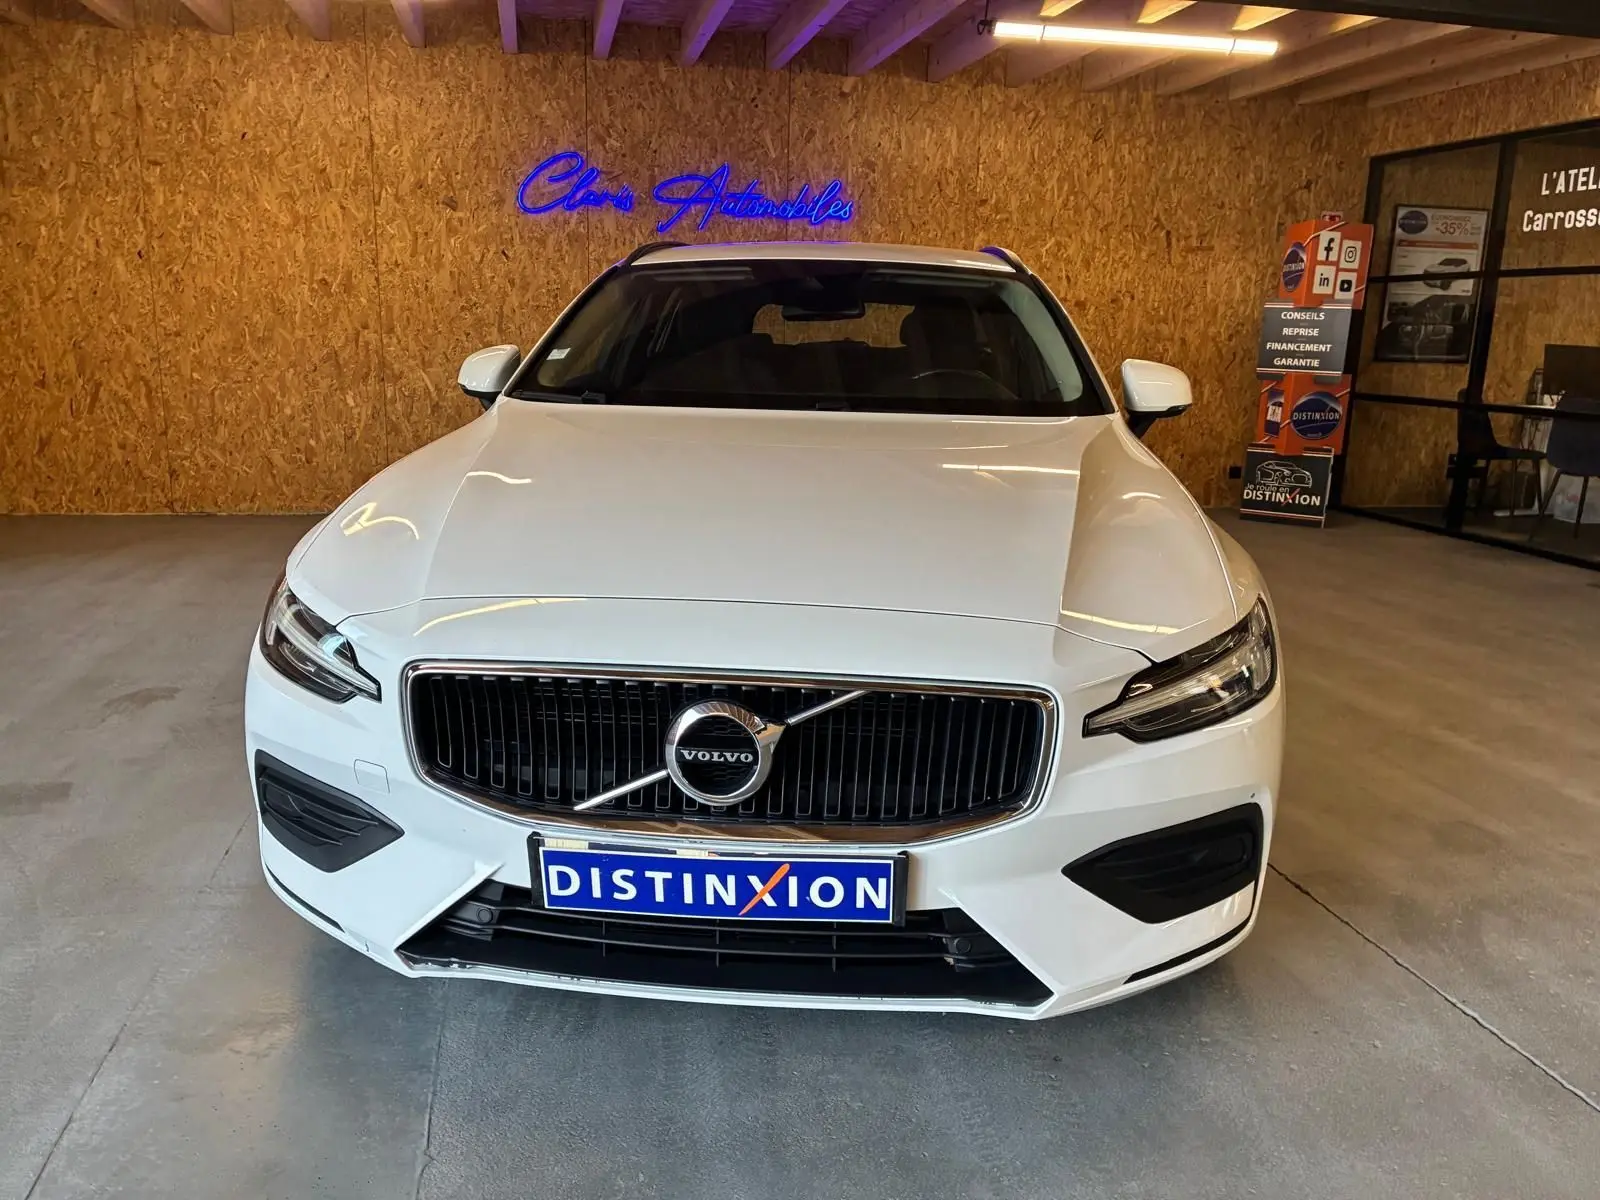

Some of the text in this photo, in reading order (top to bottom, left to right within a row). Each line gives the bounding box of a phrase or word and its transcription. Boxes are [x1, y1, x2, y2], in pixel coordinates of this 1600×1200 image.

[652, 162, 854, 232] Automobiles
[1281, 311, 1326, 321] CONSEILS
[1282, 327, 1320, 337] REPRISE
[1266, 342, 1332, 352] FINANCEMENT
[1273, 357, 1320, 367] GARANTIE
[1293, 411, 1340, 421] DISTINXION
[1256, 484, 1277, 493] roule
[1243, 489, 1321, 507] DISTINXION
[680, 749, 754, 763] VOLVO
[547, 863, 888, 916] DISTINXION
